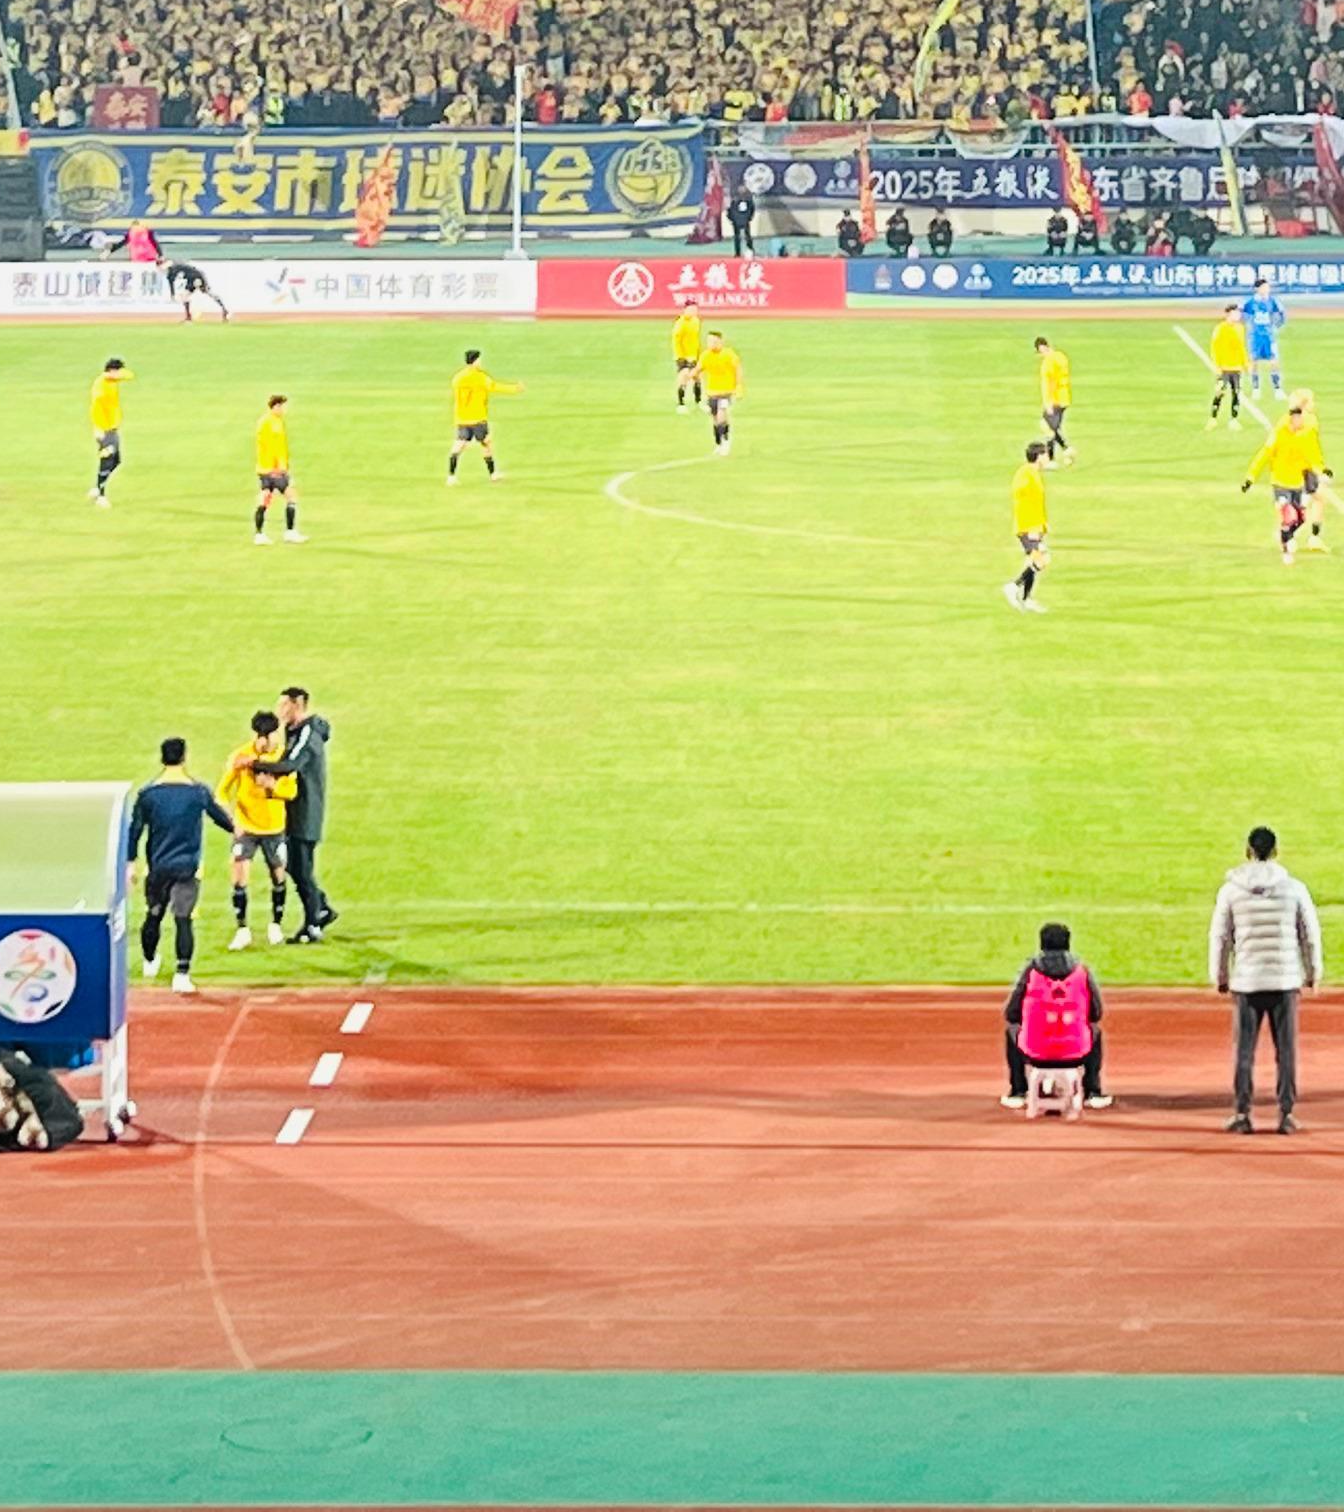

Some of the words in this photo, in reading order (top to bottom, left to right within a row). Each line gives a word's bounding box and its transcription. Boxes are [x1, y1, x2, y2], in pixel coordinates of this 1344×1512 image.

[315, 273, 498, 299] 中国体育彩票
